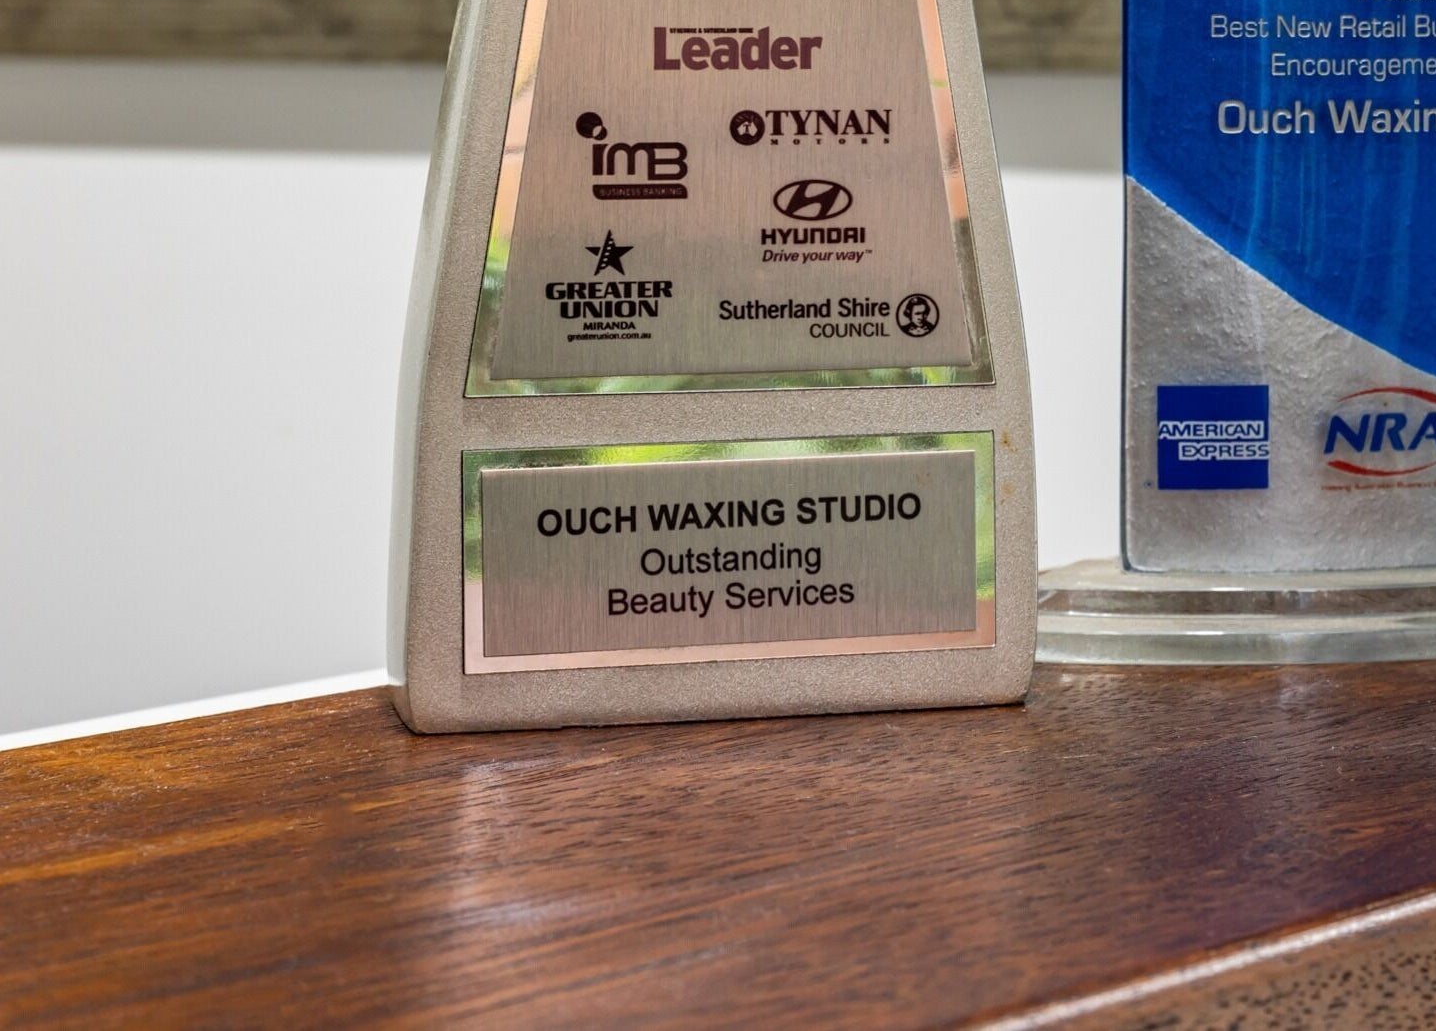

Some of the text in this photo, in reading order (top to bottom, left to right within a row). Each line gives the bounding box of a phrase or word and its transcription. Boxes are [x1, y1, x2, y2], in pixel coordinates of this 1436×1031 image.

[1210, 14, 1269, 39] Best
[1276, 15, 1332, 39] New
[1339, 14, 1406, 39] Retail
[653, 26, 823, 71] Leader
[765, 109, 892, 135] TYNAN
[1218, 100, 1315, 135] Ouch
[769, 137, 891, 146] MOTORS
[761, 227, 865, 245] HYUNDAI
[762, 249, 799, 263] Drive
[802, 252, 834, 264] your
[545, 281, 673, 300] GREATER
[560, 300, 658, 319] UNION
[719, 297, 890, 320] Sutherland Shire
[581, 320, 638, 332] MIRANDA
[809, 322, 889, 339] COUNCIL
[566, 331, 653, 343] greaterunion.com.au
[1159, 423, 1262, 438] AMERICAN
[1181, 444, 1270, 459] EXPRESS
[537, 492, 922, 537] OUCH WAXING STUDIO
[640, 542, 822, 576] Outstanding
[607, 579, 855, 619] Beauty Services
